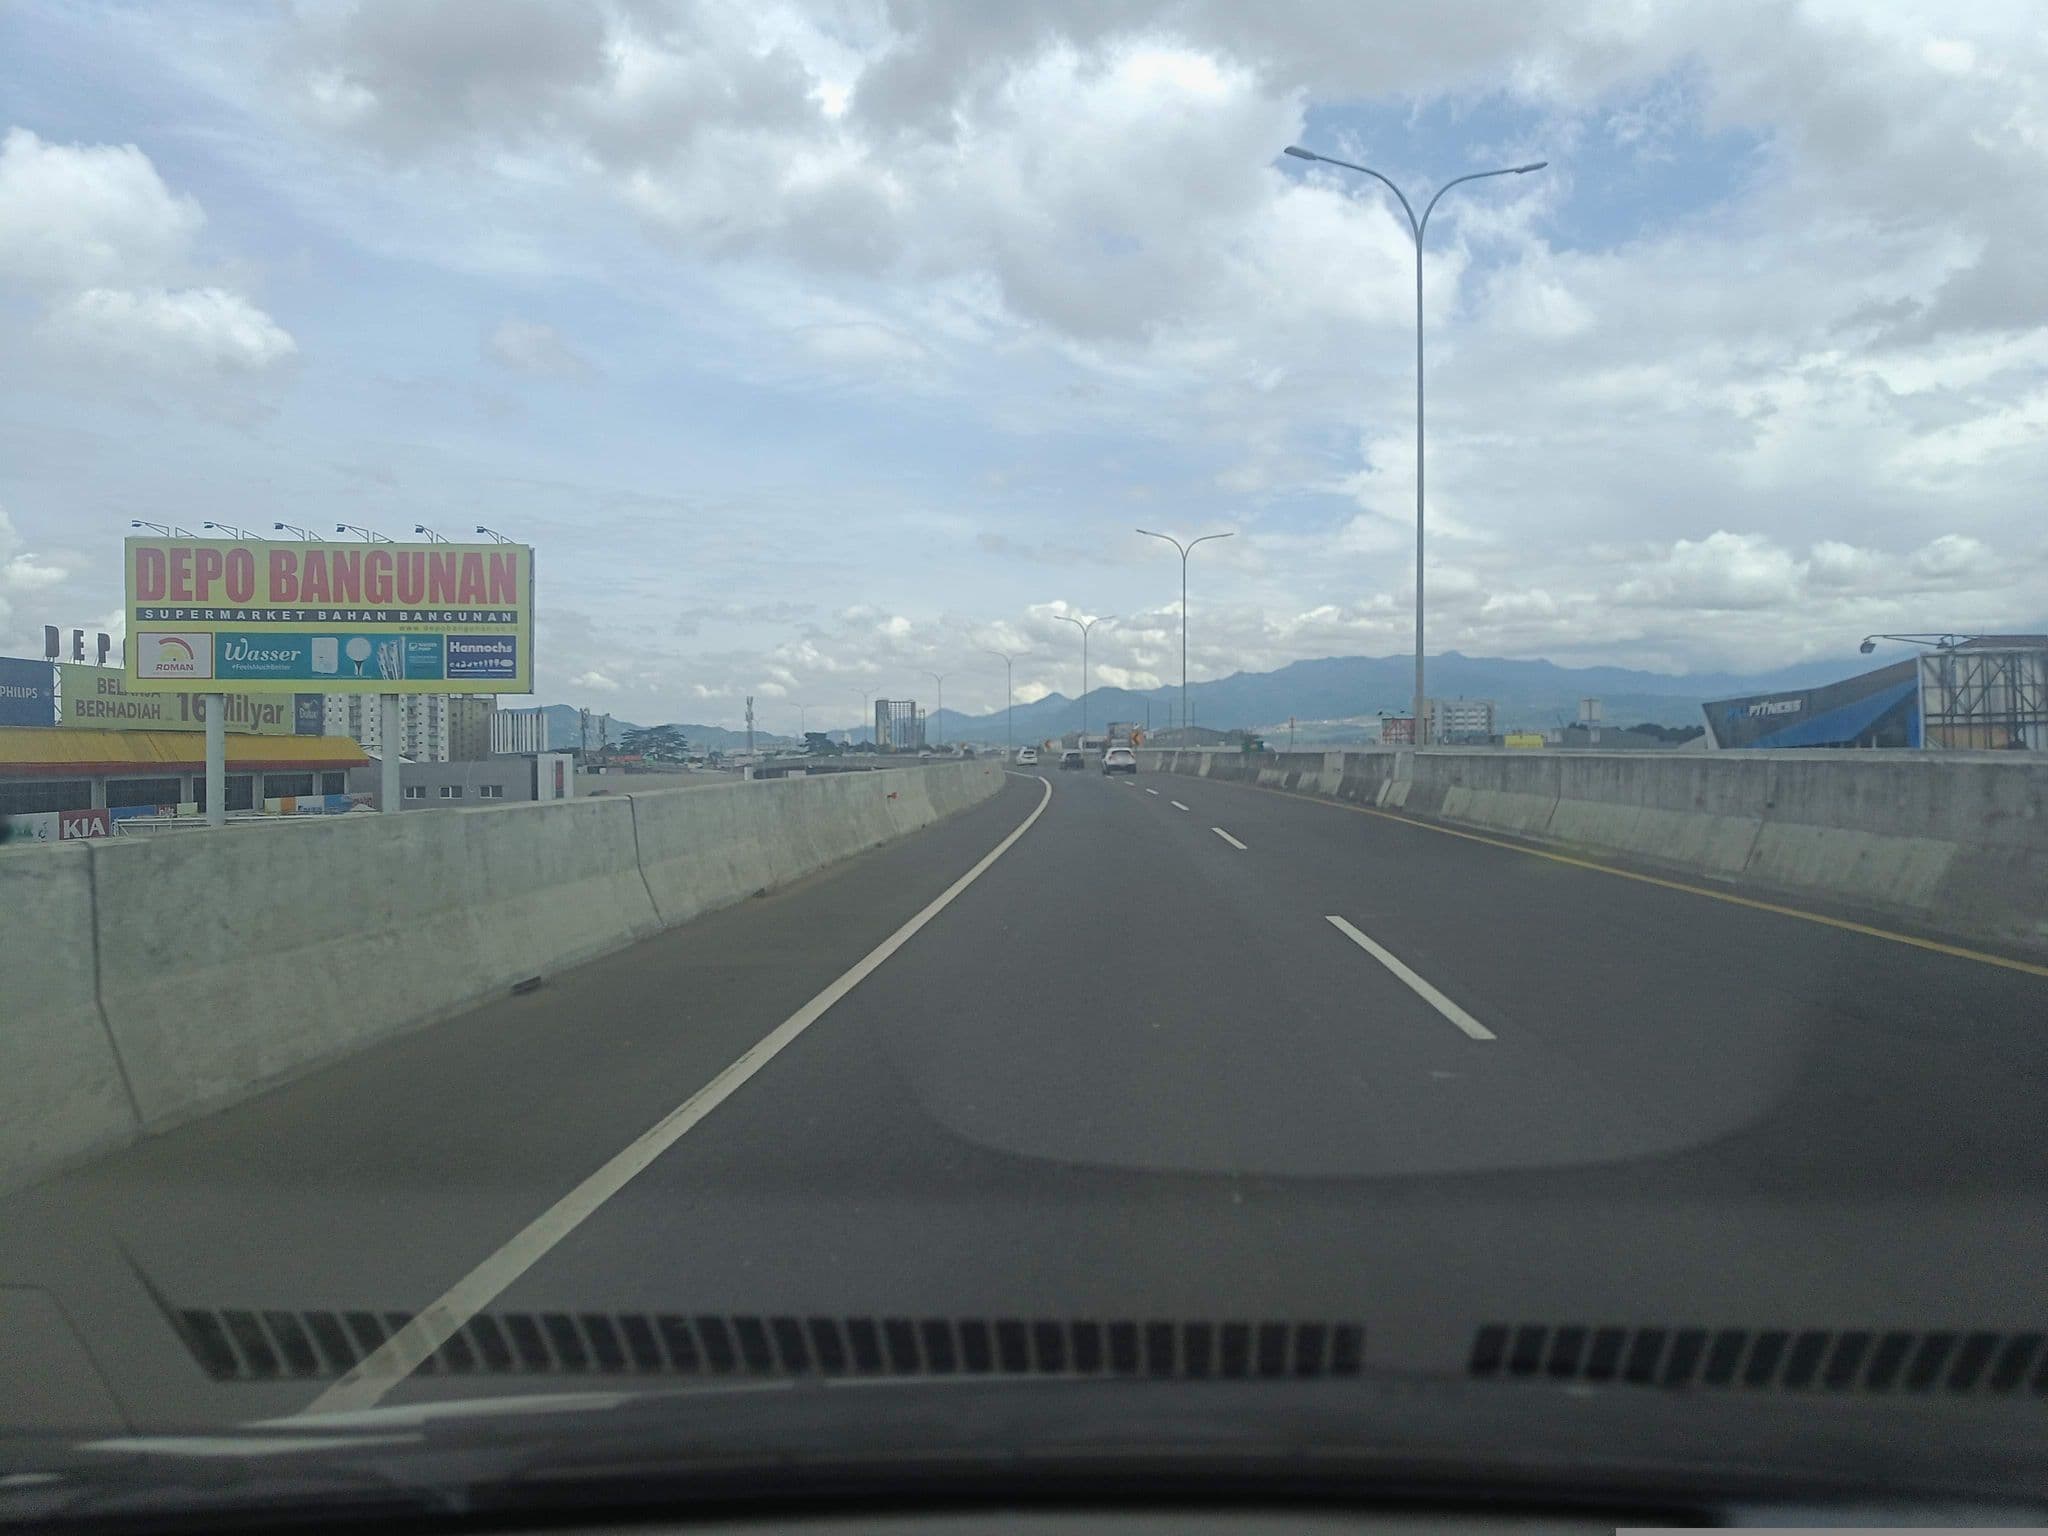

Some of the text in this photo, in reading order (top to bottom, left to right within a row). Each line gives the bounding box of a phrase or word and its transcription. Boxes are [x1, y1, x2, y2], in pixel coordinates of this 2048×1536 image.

[136, 547, 517, 605] DEPO BANGUNAN
[145, 609, 512, 622] SUPERMARKET BAHAN BANGUNAN
[45, 625, 126, 665] DEP
[224, 636, 302, 662] Wasser
[449, 641, 513, 653] Hannochs
[155, 663, 194, 672] ROMAN
[0, 686, 39, 699] PHILIPS
[75, 699, 161, 720] BERHADIAH
[63, 817, 106, 839] KIA
